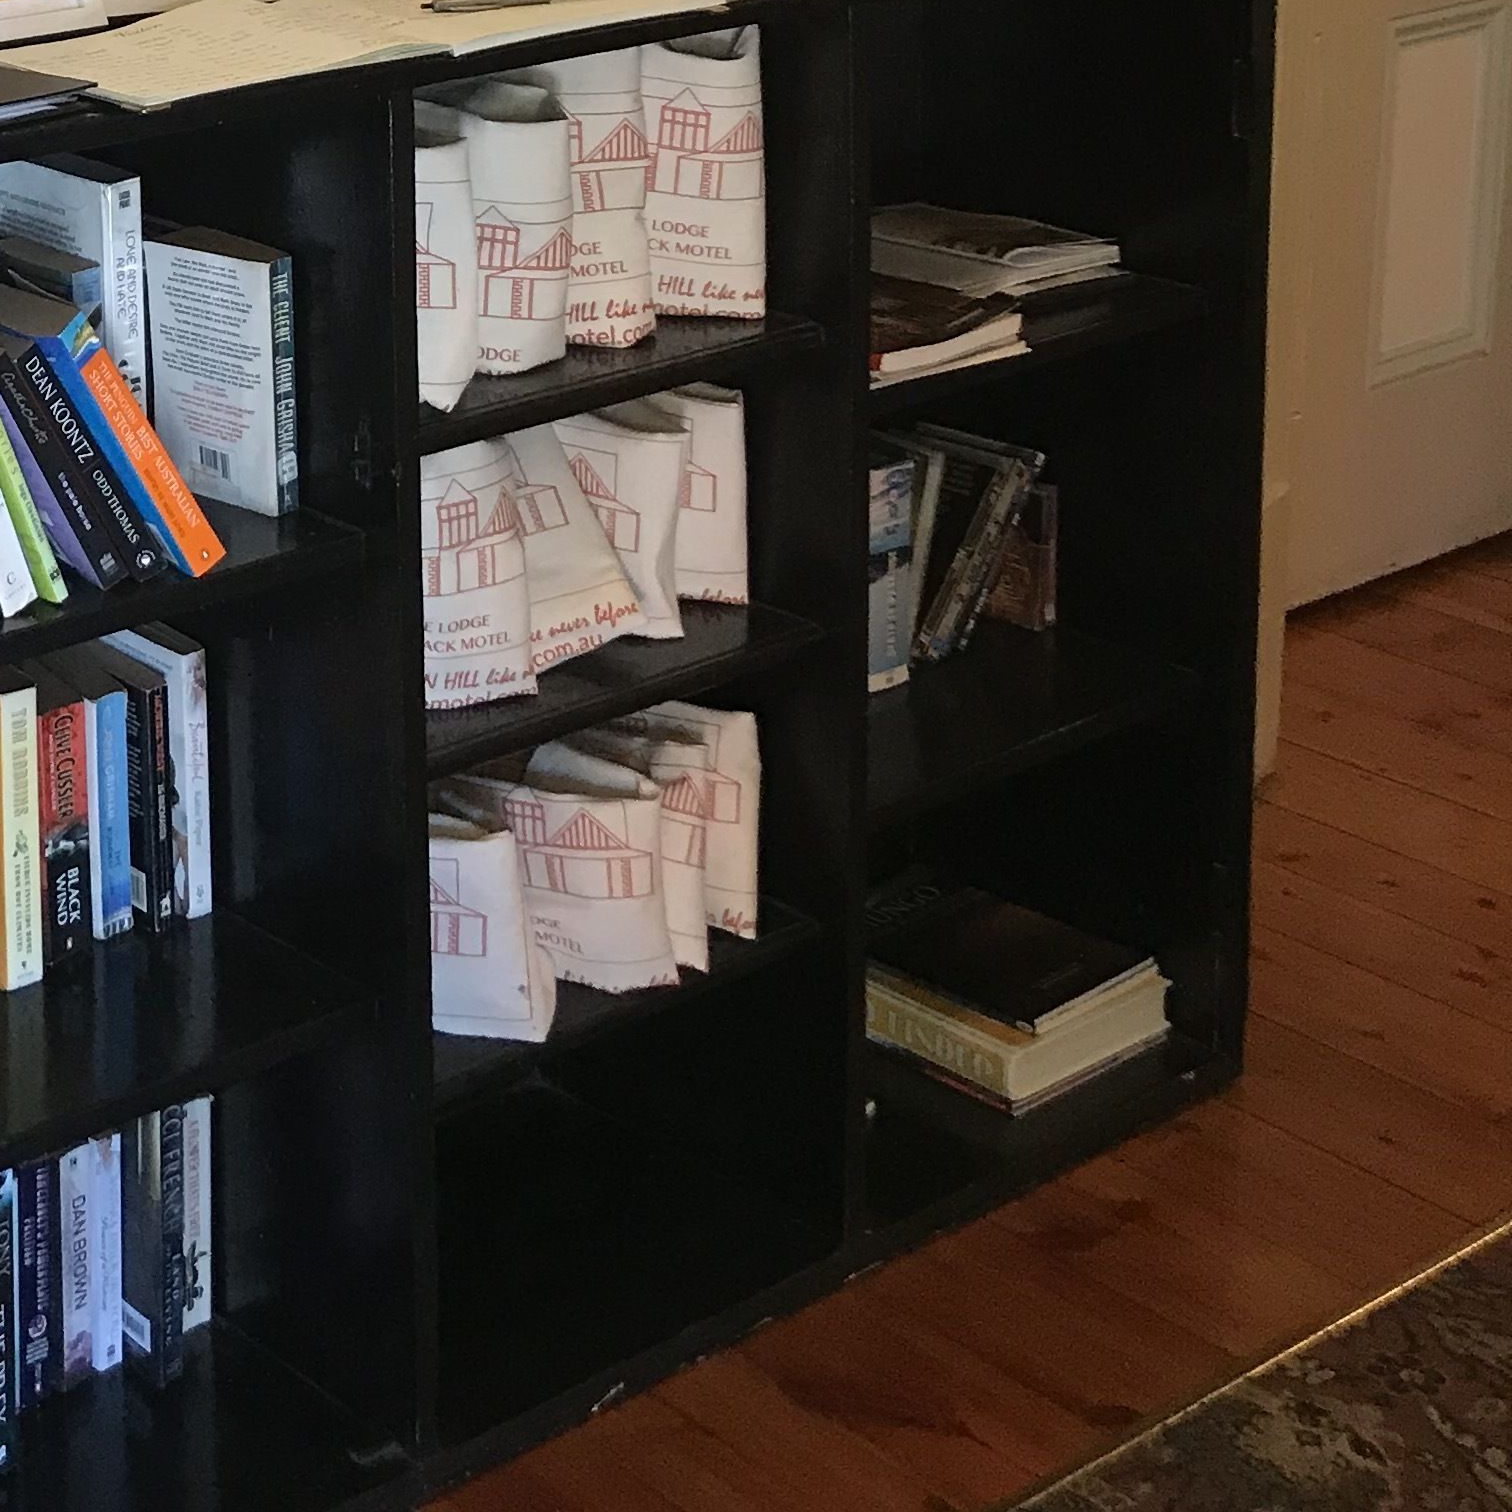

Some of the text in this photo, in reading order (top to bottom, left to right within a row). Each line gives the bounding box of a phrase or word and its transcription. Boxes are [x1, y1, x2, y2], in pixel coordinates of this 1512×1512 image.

[569, 240, 603, 256] DGE
[652, 219, 710, 238] LODGE
[570, 261, 628, 277] MOTEL
[675, 243, 733, 260] MOTEL
[272, 272, 290, 344] THE CLIENT
[605, 299, 638, 320] like
[658, 274, 695, 298] HILL
[702, 280, 736, 301] like
[477, 348, 522, 363] ODGE
[25, 355, 95, 464] DEAN KOONTZ
[89, 369, 118, 411] SHORT
[112, 410, 145, 461] STORIES
[276, 356, 296, 454] JOHN GRISHA
[110, 378, 139, 424] PENGUIN
[135, 424, 159, 454] BEST
[153, 455, 201, 529] AUSTRALIAN
[58, 471, 93, 531] the pale horse
[92, 469, 141, 544] ODD THOMAS
[438, 614, 491, 634] LODGE
[594, 601, 640, 626] before
[461, 632, 511, 651] MOTEL
[444, 668, 479, 690] HILL
[11, 708, 28, 744] TOM
[54, 713, 76, 820] CLIVE CUSSLER
[55, 873, 68, 926] WIND
[66, 867, 81, 924] BLACK
[162, 1152, 181, 1234] FRENCH
[72, 1194, 88, 1310] DAN BROWN
